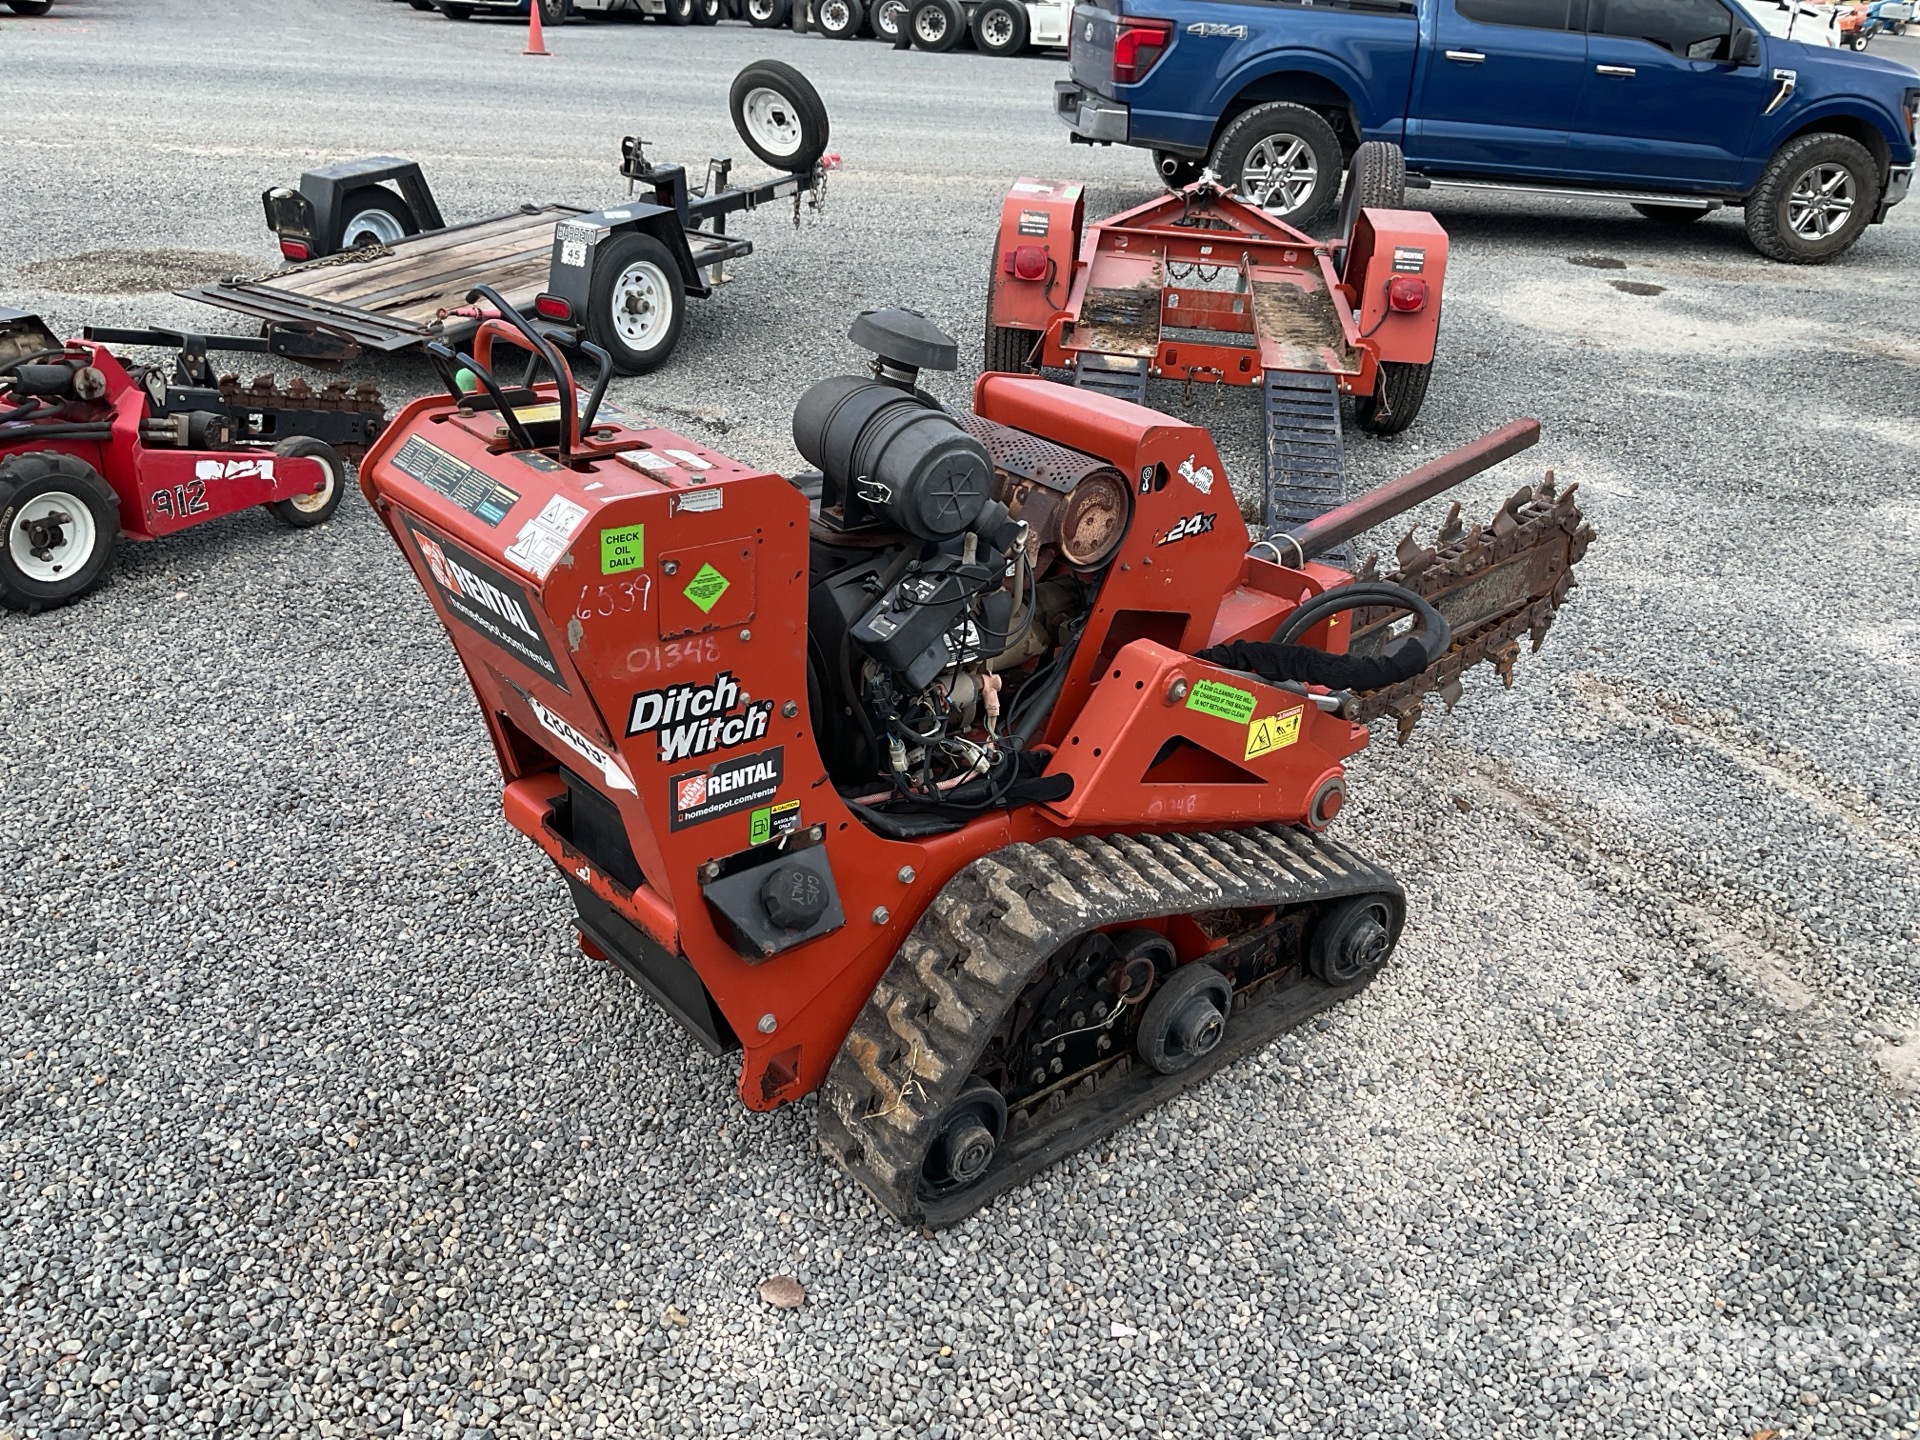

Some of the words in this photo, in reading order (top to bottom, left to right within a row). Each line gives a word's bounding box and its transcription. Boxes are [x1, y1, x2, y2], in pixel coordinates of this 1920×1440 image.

[556, 225, 597, 246] BARRETO
[567, 249, 580, 260] 45
[1180, 463, 1191, 477] Fee
[152, 479, 209, 519] 912
[605, 531, 639, 545] CHECK
[614, 545, 631, 555] OIL
[609, 556, 636, 568] DAILY
[446, 556, 540, 641] RENTAL
[576, 574, 652, 619] 6539
[626, 635, 721, 672] 01348
[629, 675, 738, 733] Ditch
[1200, 691, 1220, 703] CHARGED
[1225, 699, 1234, 707] THIS
[1235, 702, 1253, 712] MACHINE
[1213, 687, 1234, 698] CLEANING
[1243, 696, 1252, 704] WILL
[1210, 703, 1231, 714] RETURNED
[1231, 709, 1245, 718] CLEAN
[1282, 708, 1301, 718] DANGER
[660, 704, 767, 762] Witch
[707, 760, 777, 797] RENTAL
[679, 774, 706, 809] HOME
[685, 786, 777, 820] homedepot.com/rental
[777, 802, 799, 811] CAUTION
[773, 814, 797, 825] GASOLINE
[791, 871, 804, 906] ONLY
[807, 874, 820, 905] GAS
